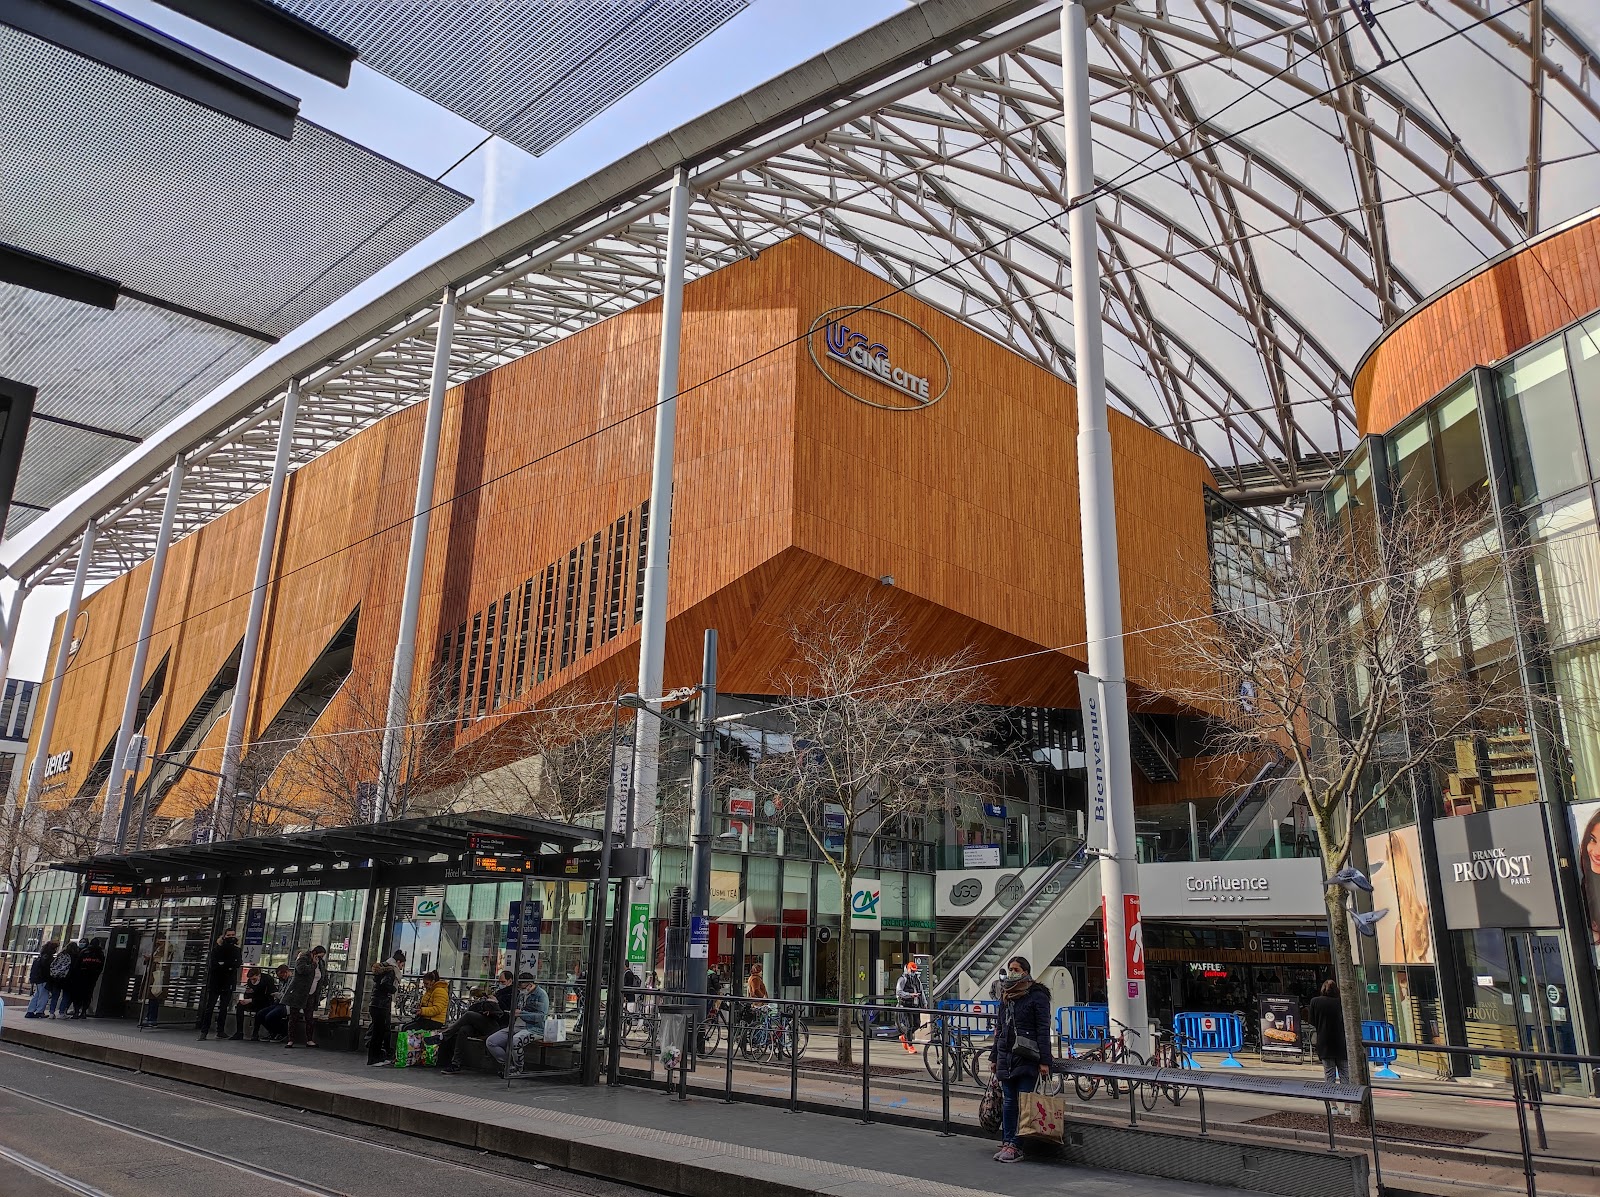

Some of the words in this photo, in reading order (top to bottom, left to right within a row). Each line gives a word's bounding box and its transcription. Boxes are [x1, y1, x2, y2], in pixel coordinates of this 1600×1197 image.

[850, 346, 892, 380] CINÉ
[891, 367, 930, 398] CITÉ
[1088, 697, 1105, 822] Bienvenue
[1472, 848, 1506, 861] FRANCK
[445, 867, 460, 878] Hôtel
[1452, 855, 1532, 882] PROVOST
[1185, 875, 1269, 892] Confluence
[1510, 877, 1532, 885] PARIS
[952, 885, 979, 898] UGC
[1189, 962, 1221, 972] WAFFLE
[1204, 970, 1228, 978] factory
